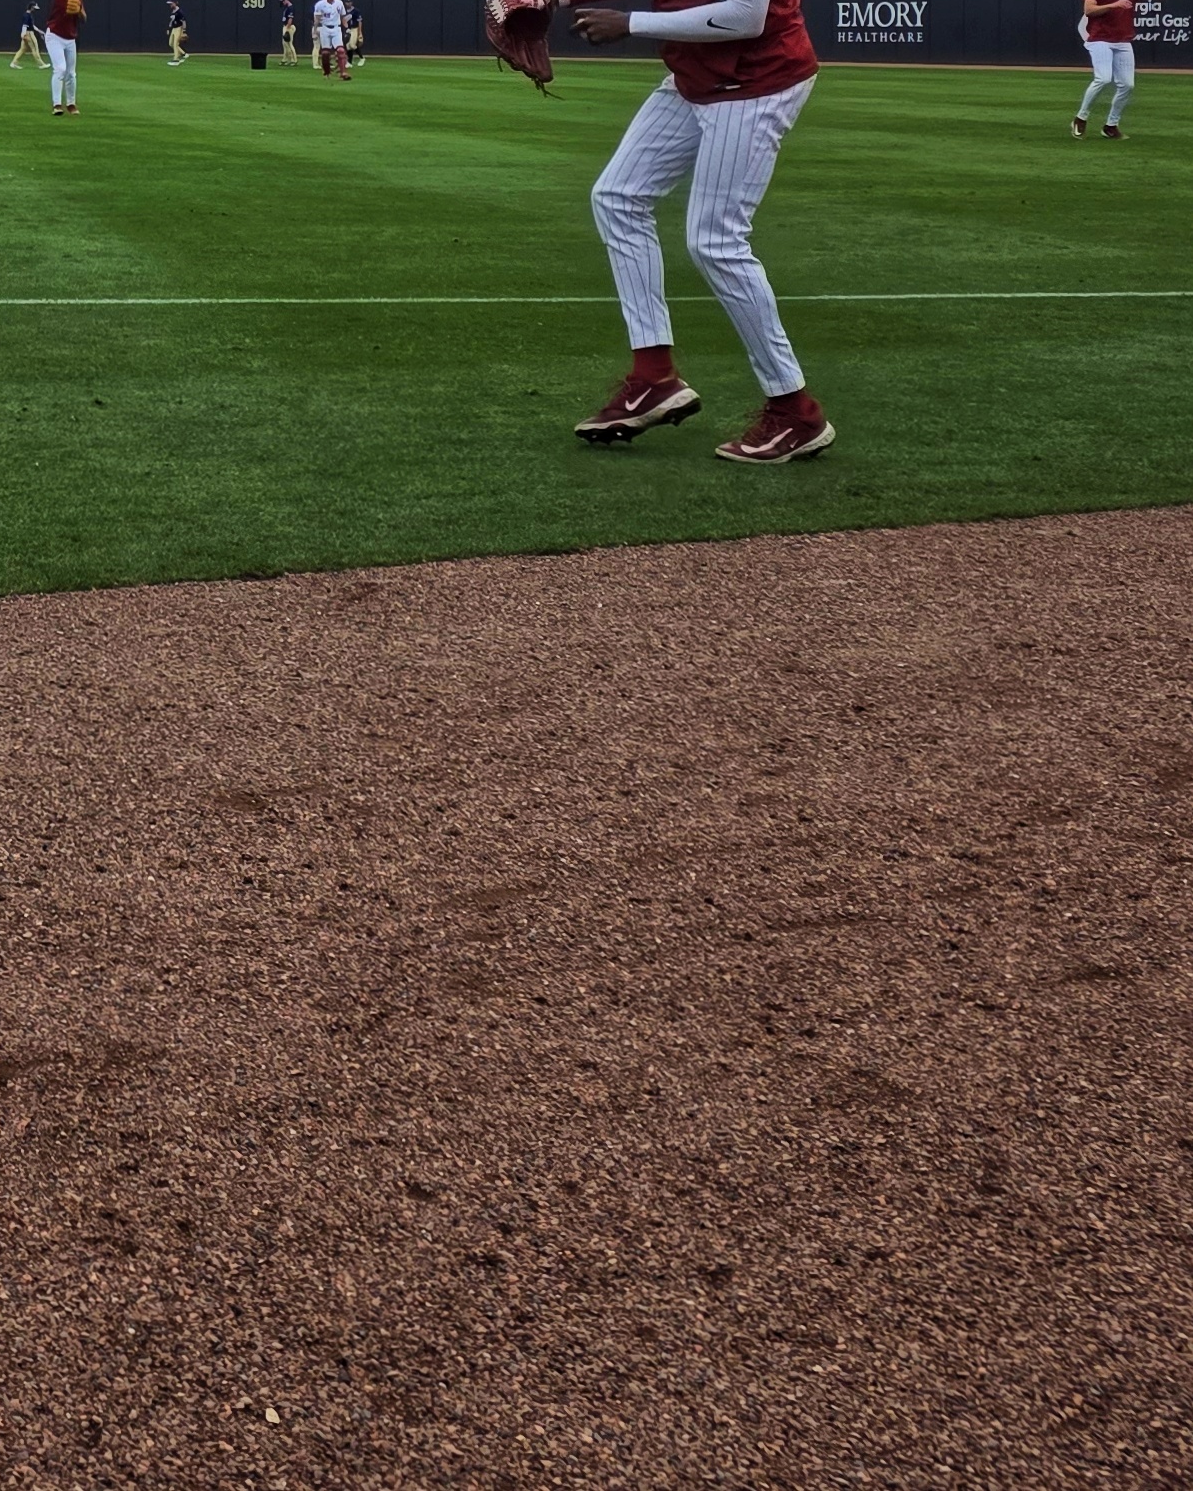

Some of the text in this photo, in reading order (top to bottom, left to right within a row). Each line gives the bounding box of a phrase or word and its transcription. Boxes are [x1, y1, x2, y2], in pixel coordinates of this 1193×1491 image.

[836, 1, 928, 27] EMORY
[1134, 0, 1162, 15] rgia
[1133, 13, 1190, 28] ural Gas
[837, 31, 924, 43] HEALTHCARE
[1163, 29, 1189, 46] Life
